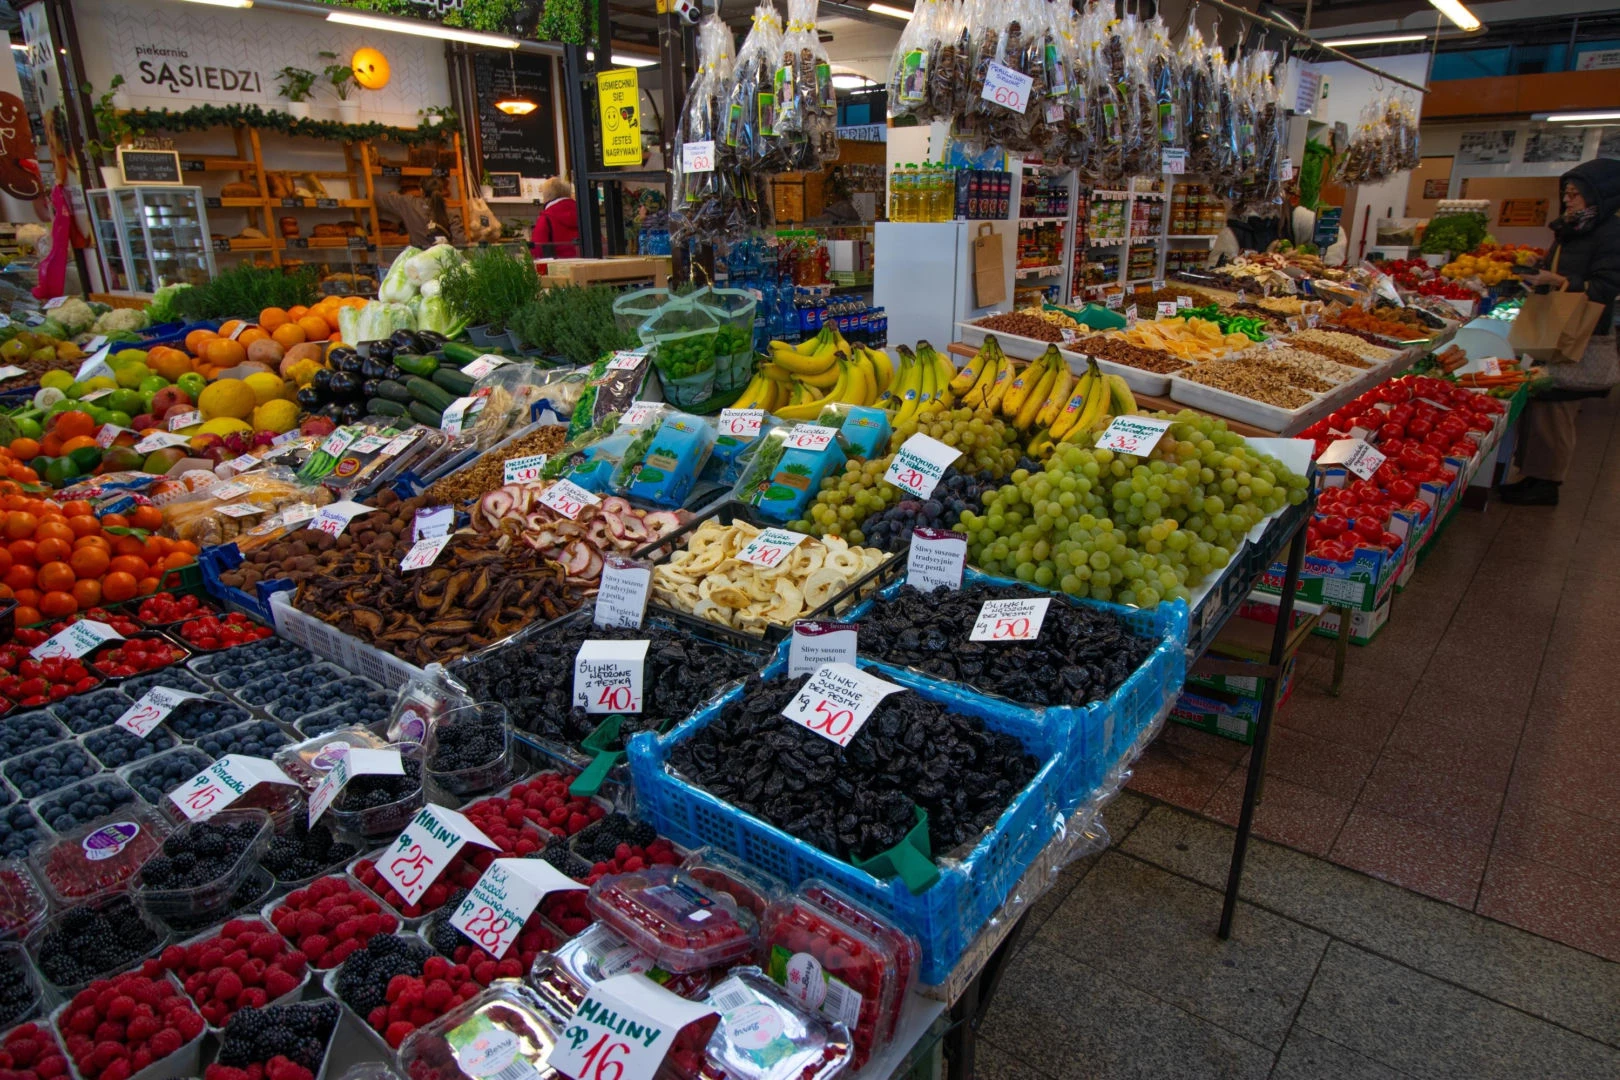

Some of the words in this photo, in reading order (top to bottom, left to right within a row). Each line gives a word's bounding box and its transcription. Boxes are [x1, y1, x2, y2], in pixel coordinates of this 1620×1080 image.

[136, 45, 188, 58] piekarnia
[139, 60, 261, 93] SĄSIEDZI
[612, 133, 632, 145] JESTEŚ
[606, 147, 638, 157] NAGRYWANY
[915, 543, 933, 555] Śliwy
[934, 548, 961, 558] suszone
[915, 554, 954, 567] tradycyjnie
[912, 562, 924, 570] bez
[925, 564, 946, 574] pestki
[922, 575, 958, 588] Węgierka
[604, 583, 637, 595] tradycyjnie
[609, 605, 640, 618] Węgierka
[801, 644, 819, 655] Śliwy
[580, 659, 617, 674] ŚLIWKI
[594, 677, 632, 689] PESTKĄ
[819, 668, 858, 689] ŚLIWKI
[818, 679, 863, 700] SUSZONE
[808, 682, 825, 695] BEZ
[827, 691, 860, 711] PESTKI
[414, 807, 462, 849] MALINY
[577, 997, 662, 1049] MALINY
